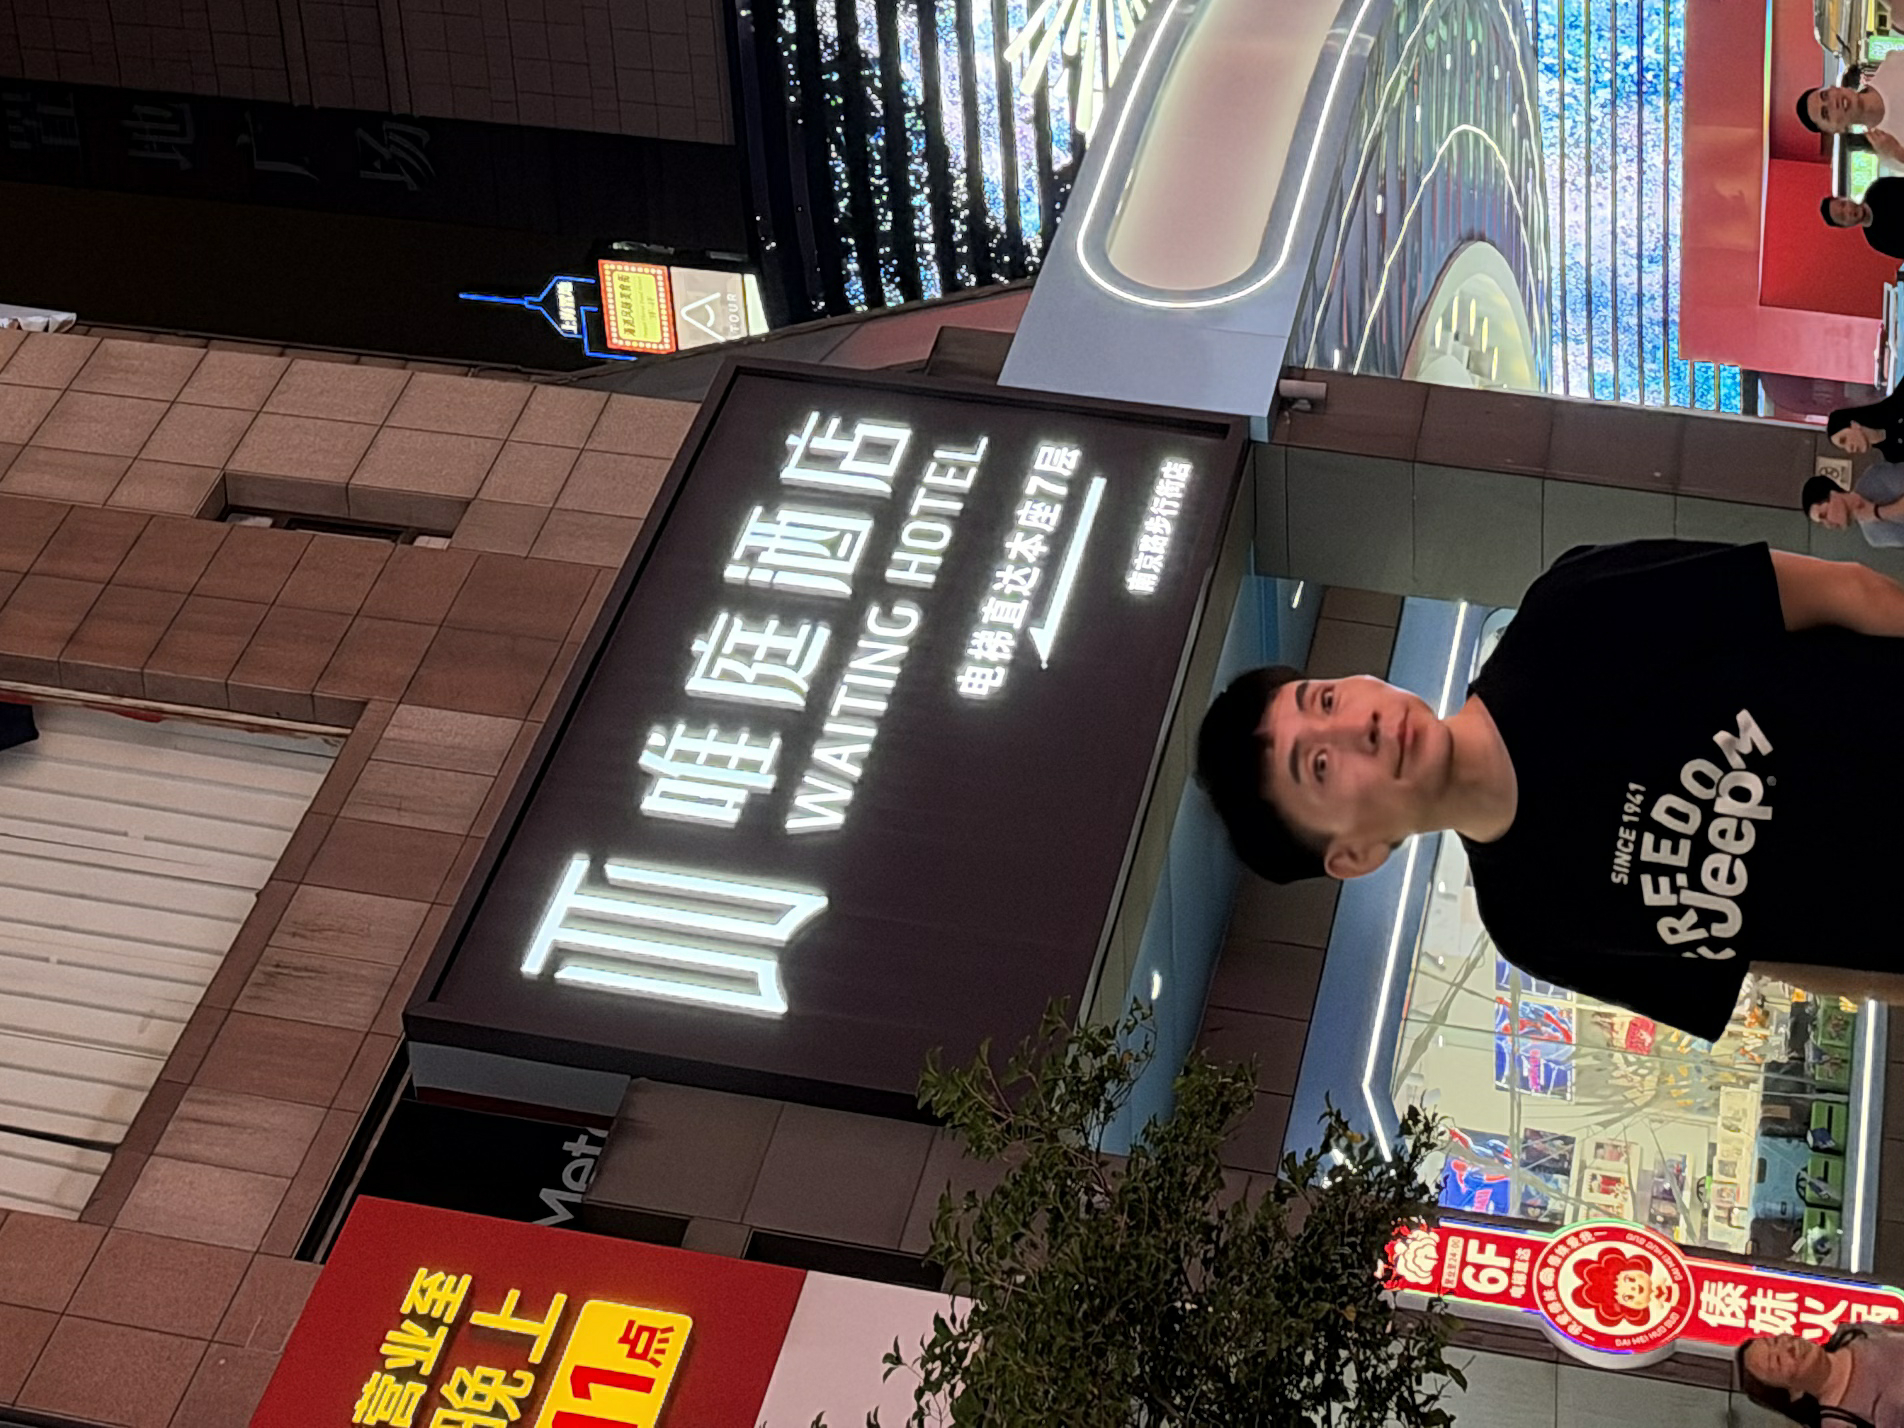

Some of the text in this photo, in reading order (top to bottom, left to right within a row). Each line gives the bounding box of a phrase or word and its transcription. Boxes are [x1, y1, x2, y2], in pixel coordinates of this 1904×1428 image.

[726, 292, 740, 337] TOUR
[956, 443, 1083, 697] 电梯直达本座7层
[1125, 460, 1194, 593] 南京路步行街店
[637, 409, 912, 828] 唯庭酒店
[784, 434, 989, 832] WAITING HOTEL
[1610, 782, 1647, 885] SINCE 1941
[1679, 770, 1774, 938] Jeep
[532, 1127, 609, 1226] Met
[1461, 1238, 1511, 1295] 6F
[1509, 1247, 1532, 1299] 电梯直达
[351, 1267, 473, 1428] 营业至
[428, 1288, 568, 1428] 晚上
